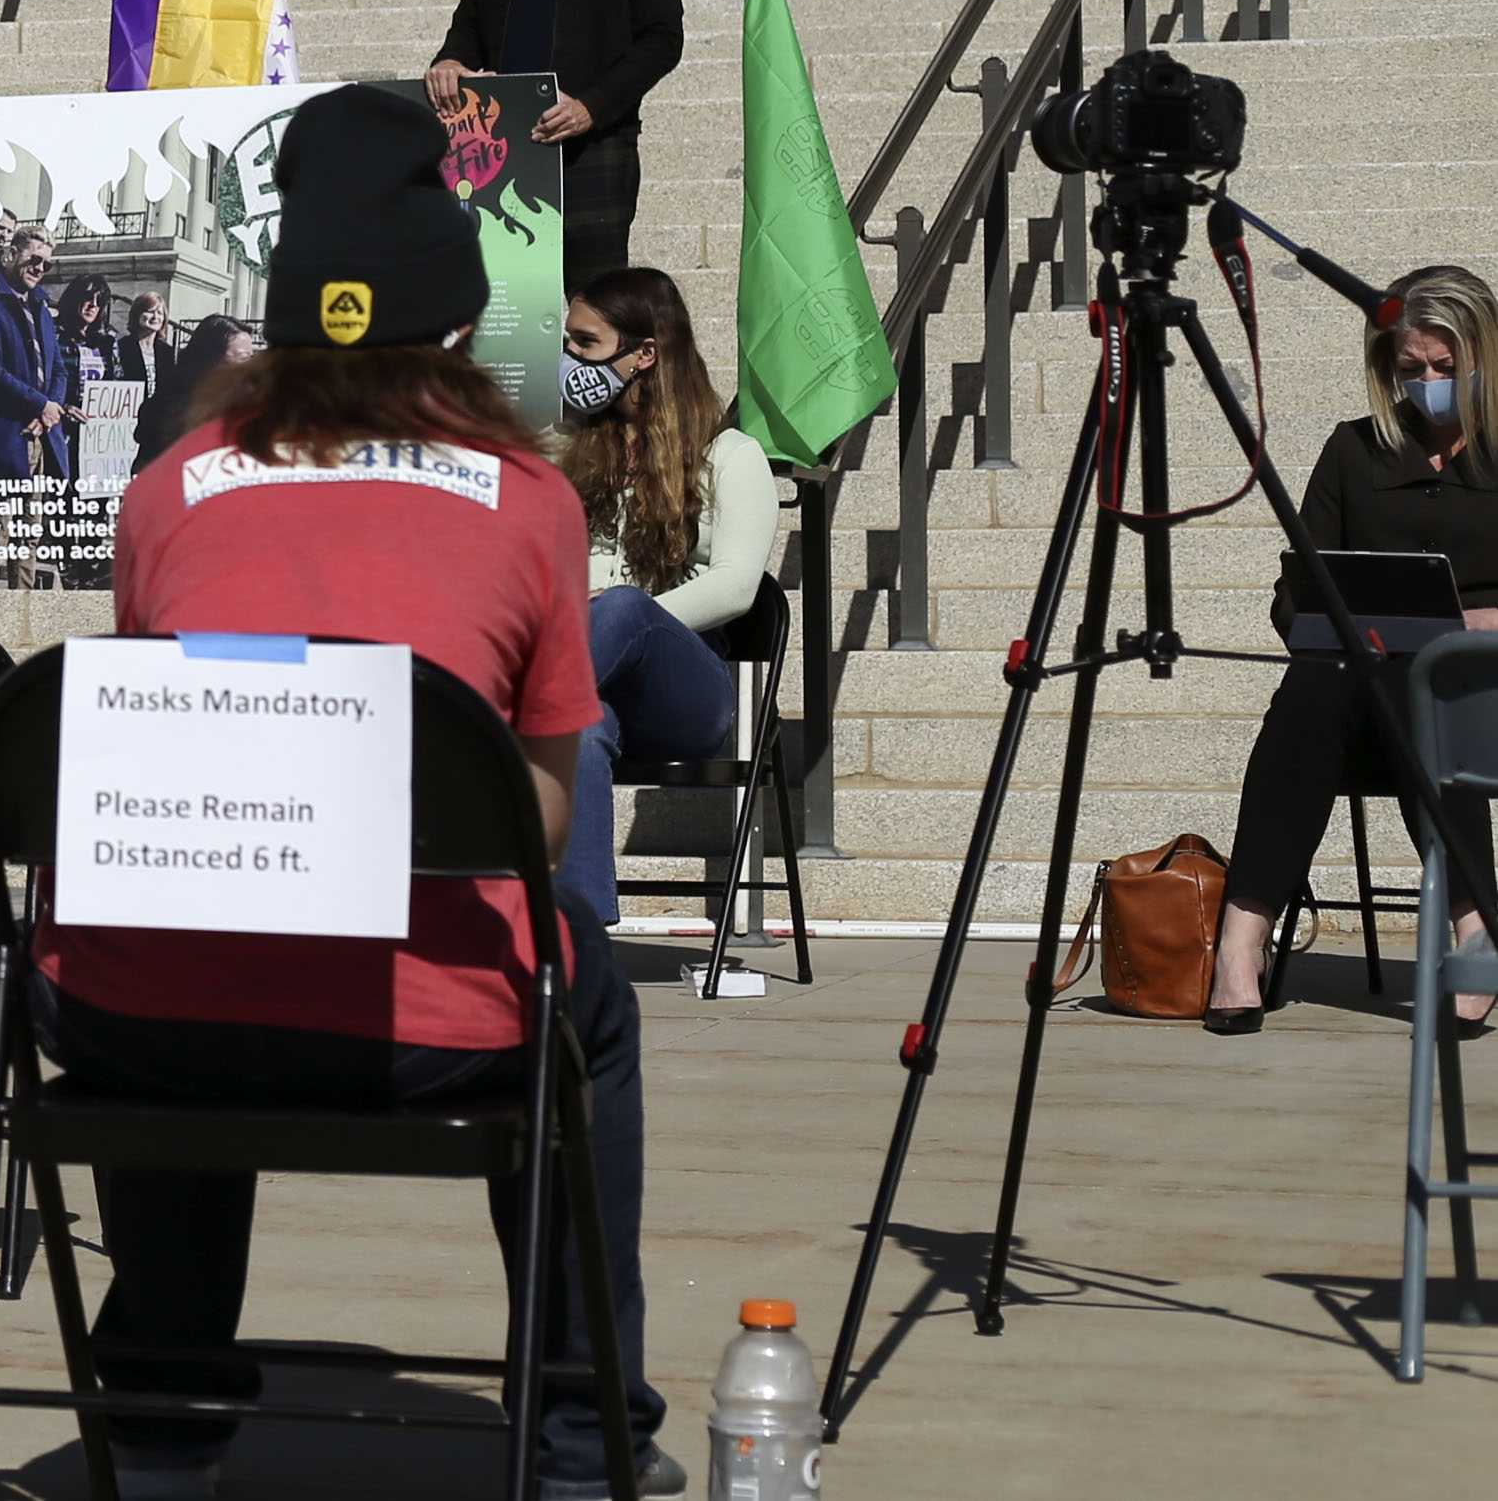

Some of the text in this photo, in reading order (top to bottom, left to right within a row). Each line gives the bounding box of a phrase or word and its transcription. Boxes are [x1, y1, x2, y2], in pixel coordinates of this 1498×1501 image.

[447, 138, 503, 180] Fire
[568, 366, 601, 392] ERA
[87, 387, 138, 419] EQUAL
[571, 384, 609, 408] YES
[74, 474, 101, 492] of
[29, 499, 67, 516] not
[72, 498, 100, 515] be
[7, 520, 44, 537] the
[36, 545, 64, 560] on
[97, 685, 375, 723] Masks Mandatory.
[94, 789, 314, 823] Please Remain
[93, 839, 311, 873] Distanced 6 ft.
